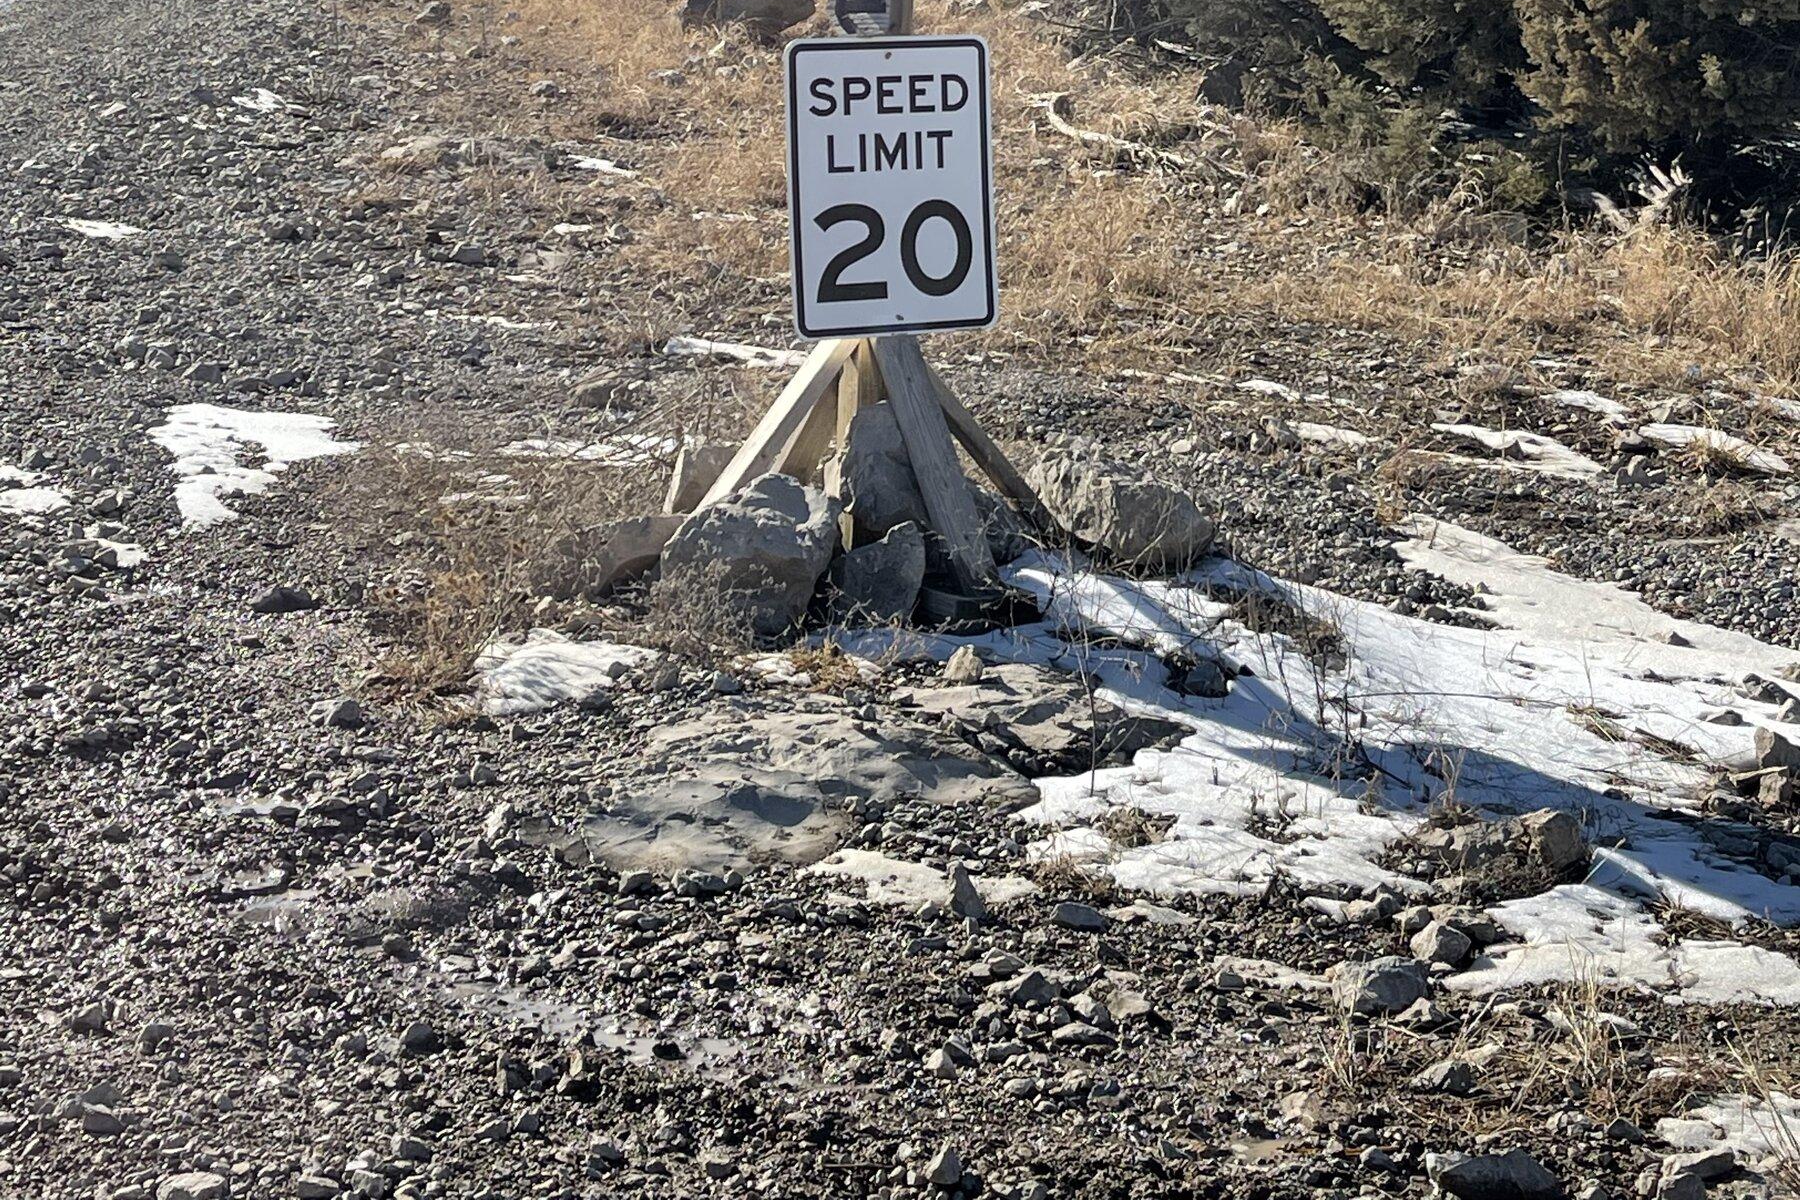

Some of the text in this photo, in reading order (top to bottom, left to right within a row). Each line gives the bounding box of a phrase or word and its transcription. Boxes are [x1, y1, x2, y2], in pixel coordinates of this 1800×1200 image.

[809, 74, 969, 116] SPEED
[827, 130, 953, 173] LIMIT
[813, 199, 973, 303] 20
